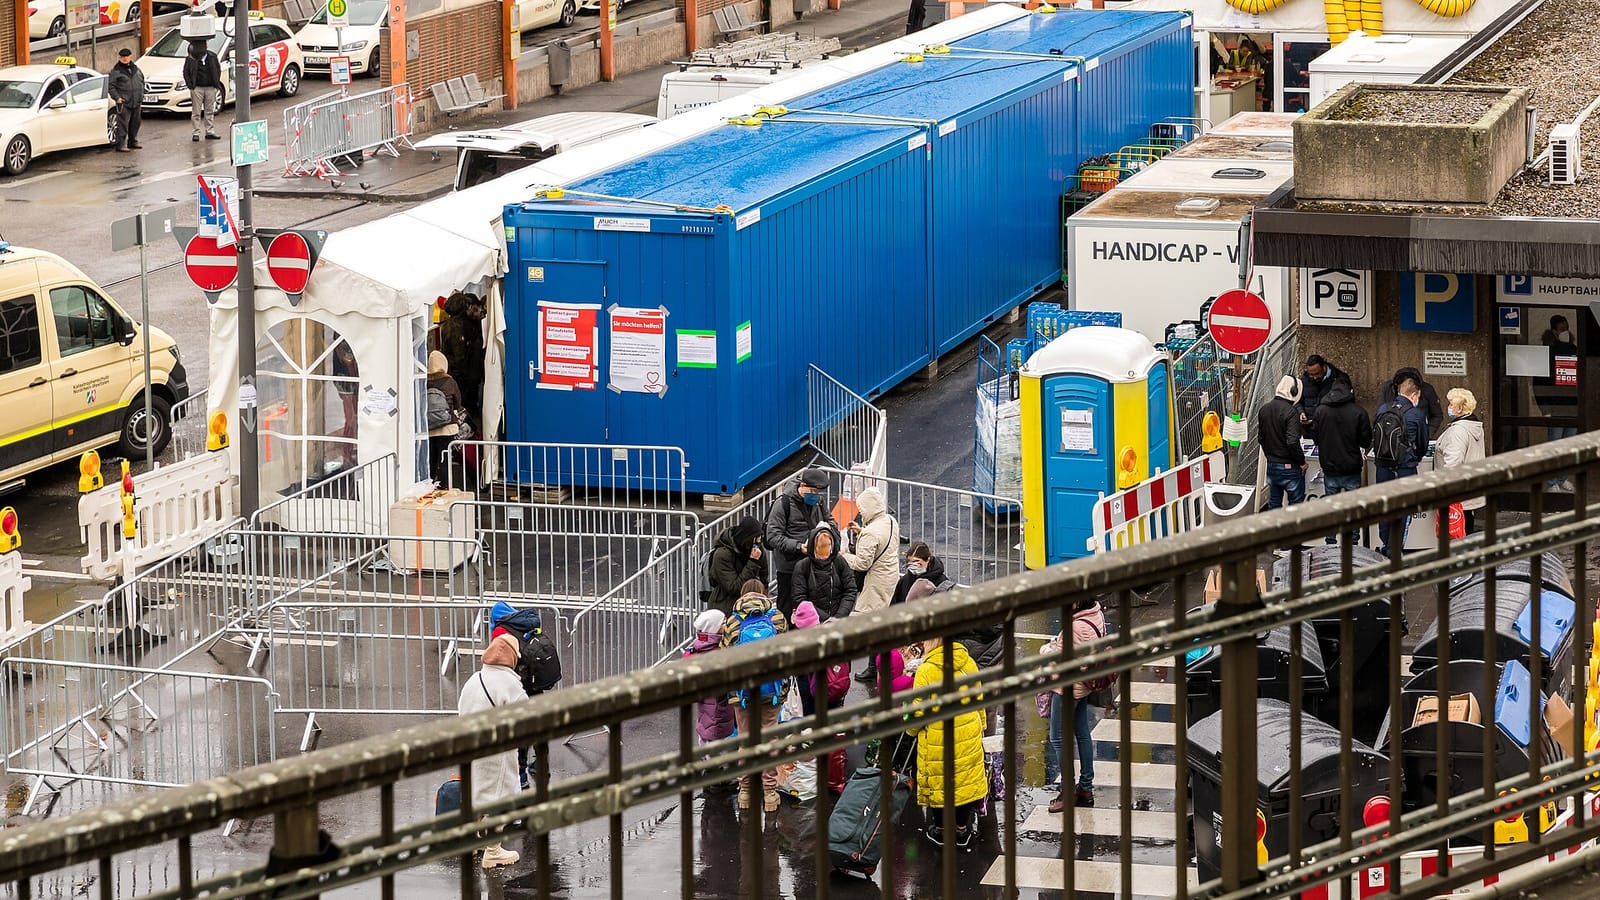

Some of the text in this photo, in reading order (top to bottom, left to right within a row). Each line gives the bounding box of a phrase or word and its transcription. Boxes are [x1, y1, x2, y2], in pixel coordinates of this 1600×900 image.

[333, 0, 342, 13] H
[1093, 241, 1208, 263] HANDICAP
[1314, 280, 1335, 309] P
[1511, 275, 1600, 296] P HAUPTBAH
[1415, 272, 1460, 324] P
[621, 321, 643, 329] möchten
